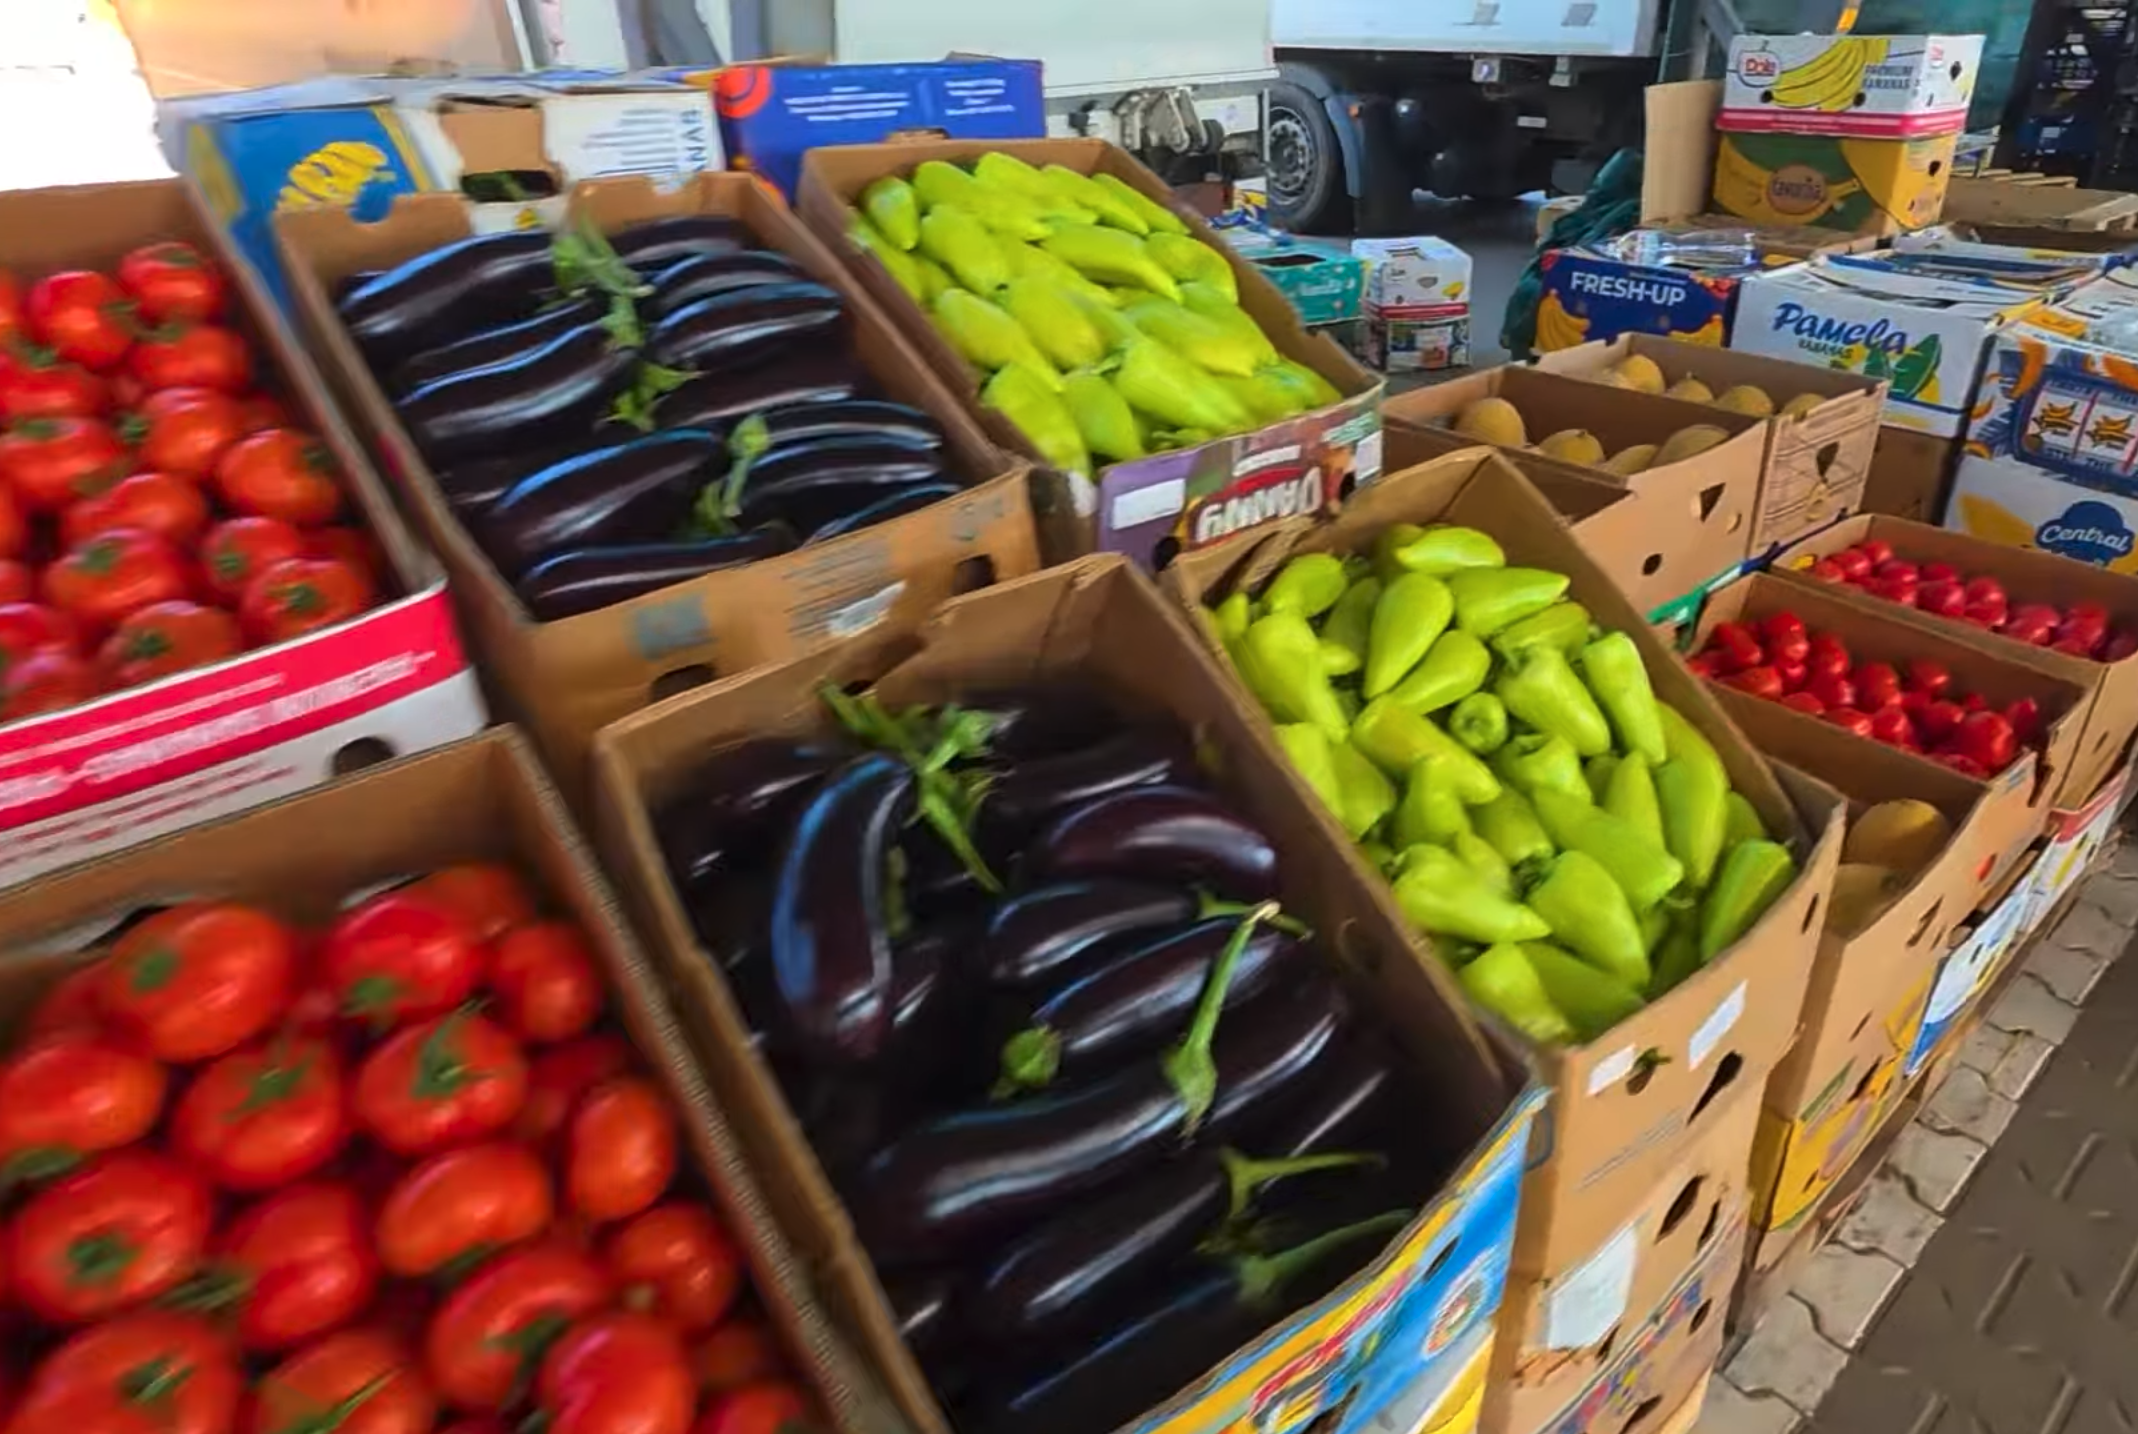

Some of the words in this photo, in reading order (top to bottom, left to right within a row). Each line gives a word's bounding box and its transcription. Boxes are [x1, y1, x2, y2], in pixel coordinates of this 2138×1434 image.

[1570, 271, 1687, 307] FRESH-UP
[1772, 301, 1908, 355] Pamela
[2041, 524, 2130, 552] Central
